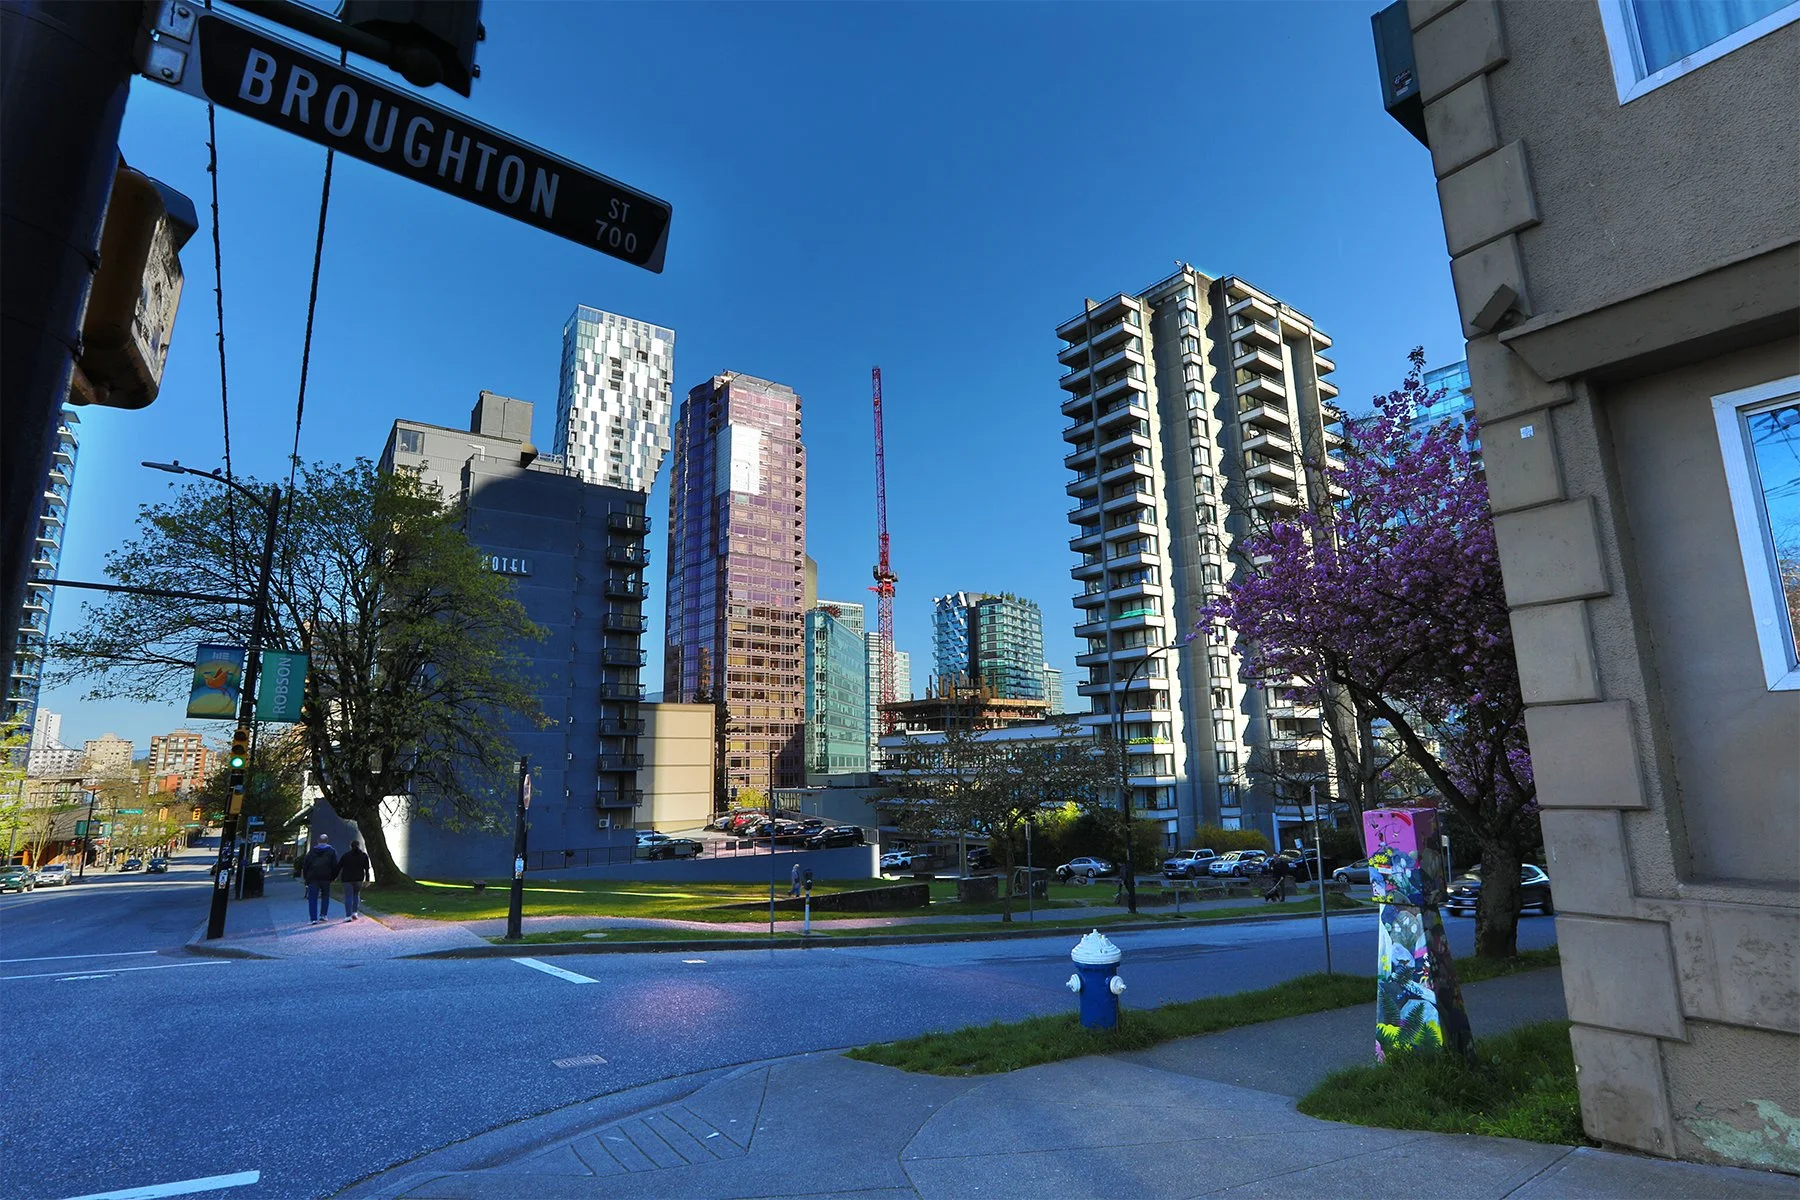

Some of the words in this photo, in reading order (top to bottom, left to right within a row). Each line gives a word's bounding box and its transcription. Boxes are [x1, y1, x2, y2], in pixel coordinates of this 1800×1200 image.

[238, 47, 560, 219] BROUGHTON
[608, 198, 630, 223] ST
[595, 218, 637, 253] 700
[272, 657, 292, 714] ROBSON
